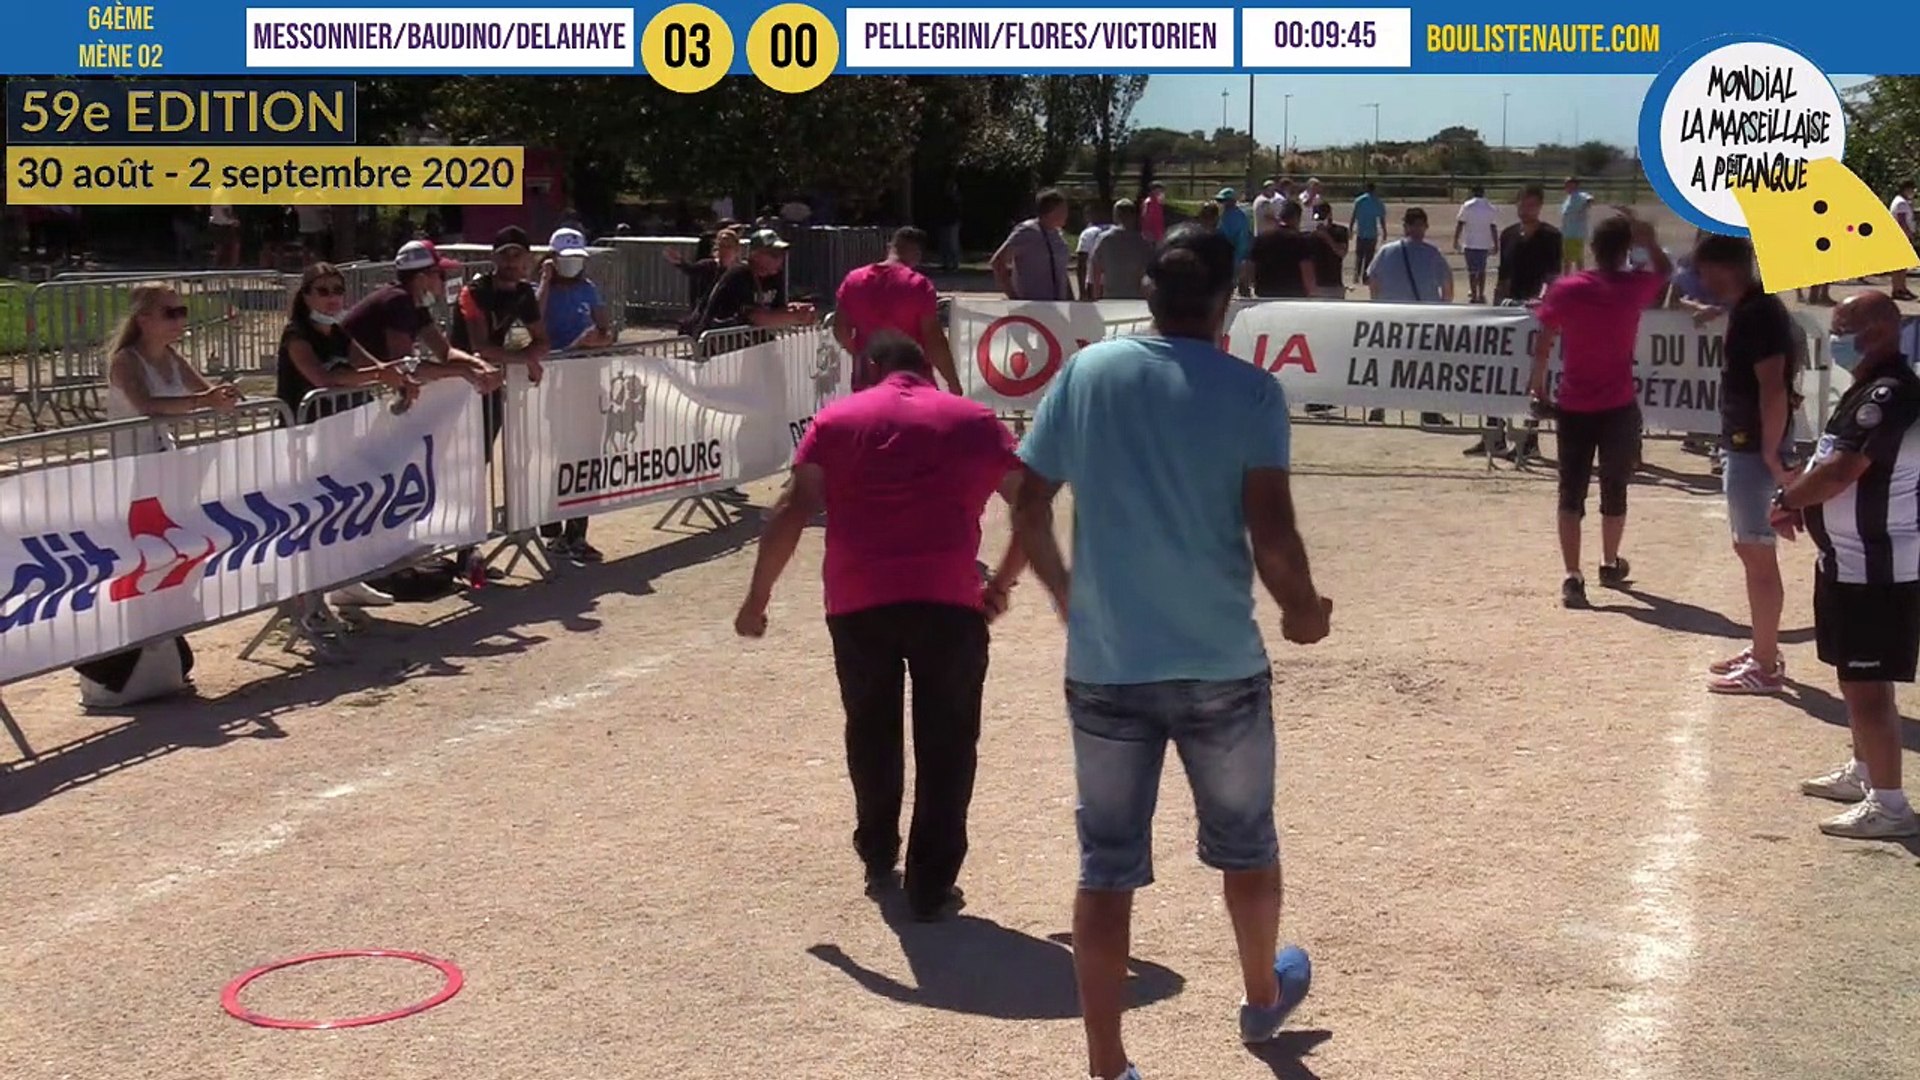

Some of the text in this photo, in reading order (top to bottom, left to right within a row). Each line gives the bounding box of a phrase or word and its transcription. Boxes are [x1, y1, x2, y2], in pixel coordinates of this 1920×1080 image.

[1353, 320, 1516, 356] PARTENAIRE
[1652, 334, 1685, 366] DU
[1347, 357, 1379, 387] LA
[558, 438, 722, 496] DERICHEBOURG
[202, 435, 437, 577] Mutuel
